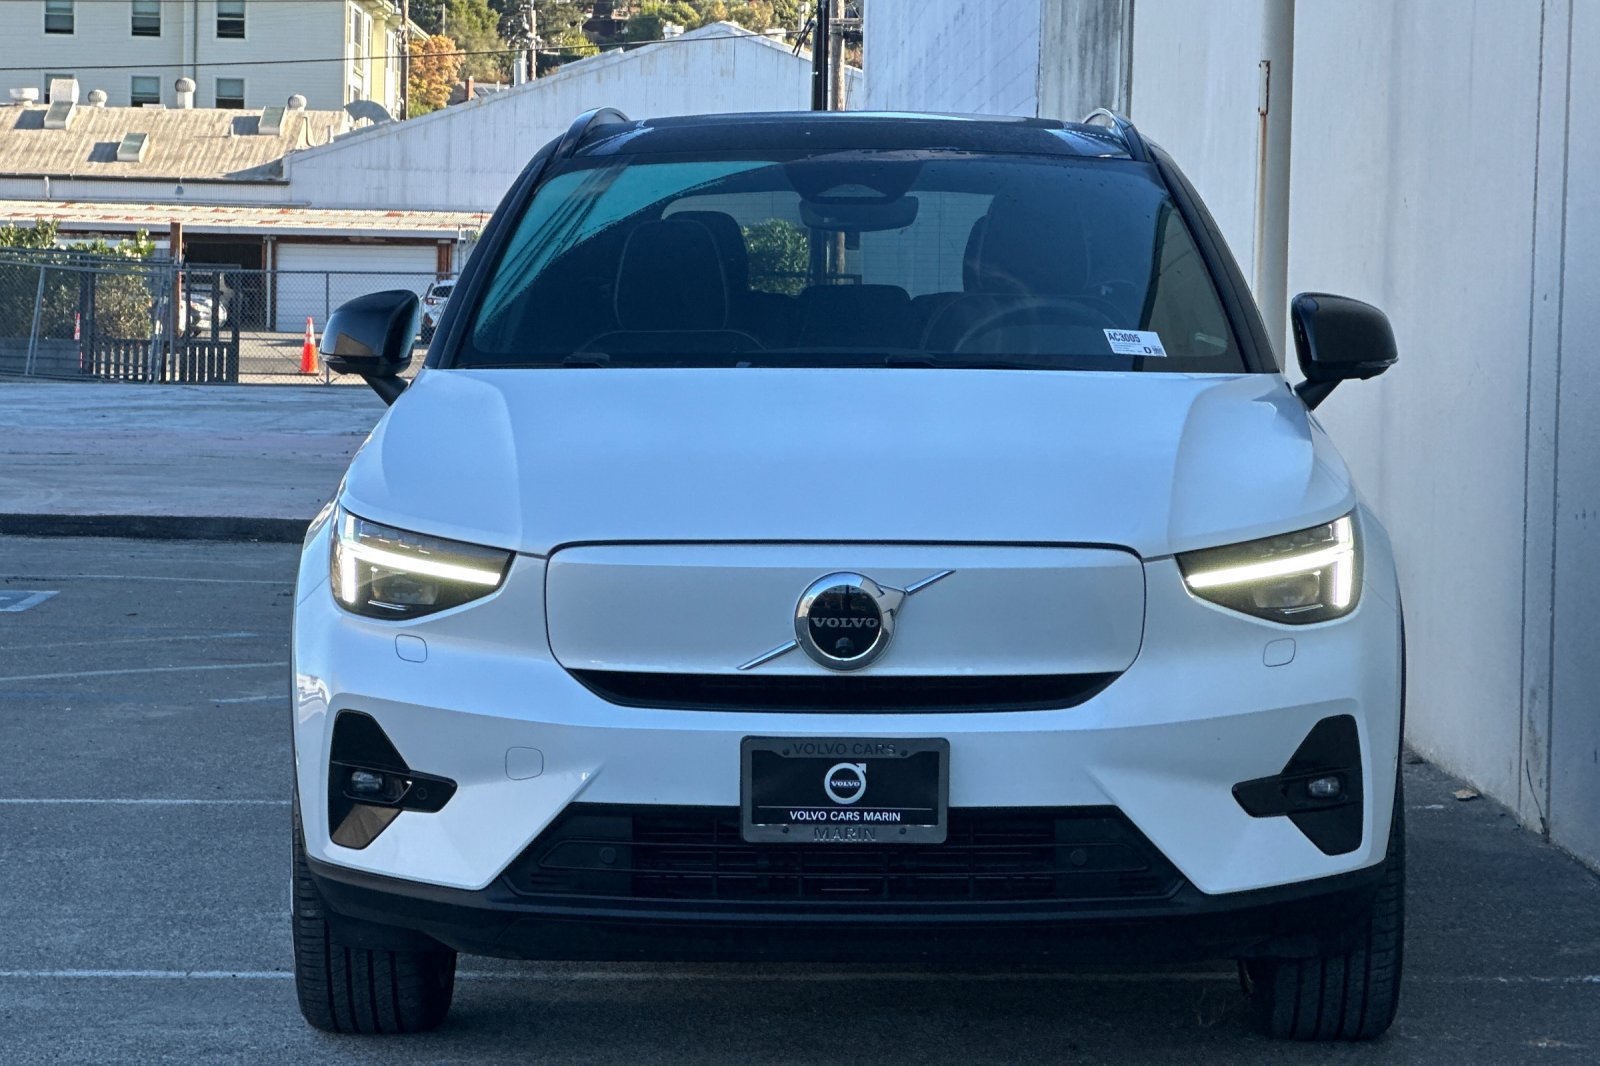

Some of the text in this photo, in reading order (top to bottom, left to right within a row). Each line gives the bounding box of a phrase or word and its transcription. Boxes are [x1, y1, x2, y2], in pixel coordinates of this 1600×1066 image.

[1108, 332, 1140, 343] AC3005
[811, 617, 879, 628] VOLVO
[793, 743, 897, 755] VOLVO CARS
[789, 810, 901, 822] VOLVO CARS MARIN
[814, 827, 876, 841] MARIN
